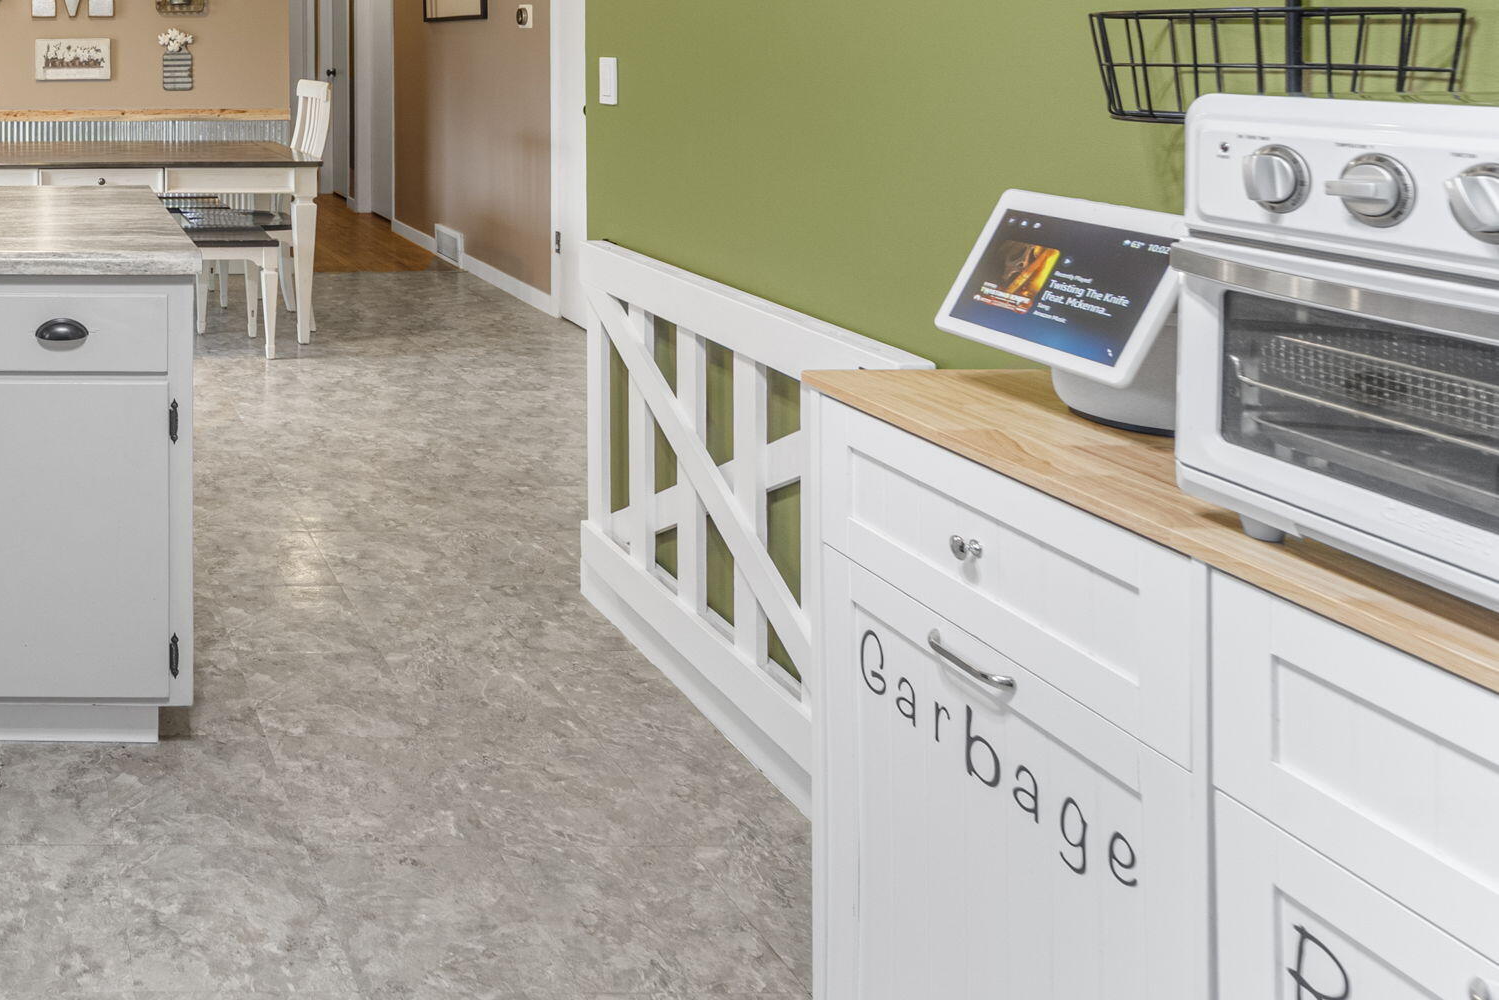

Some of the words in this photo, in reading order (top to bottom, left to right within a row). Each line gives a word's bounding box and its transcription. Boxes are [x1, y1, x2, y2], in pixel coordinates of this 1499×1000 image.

[1049, 279, 1086, 297] Twisting
[1086, 288, 1104, 301] The
[1103, 292, 1130, 307] Knife
[859, 629, 1139, 888] Garbage
